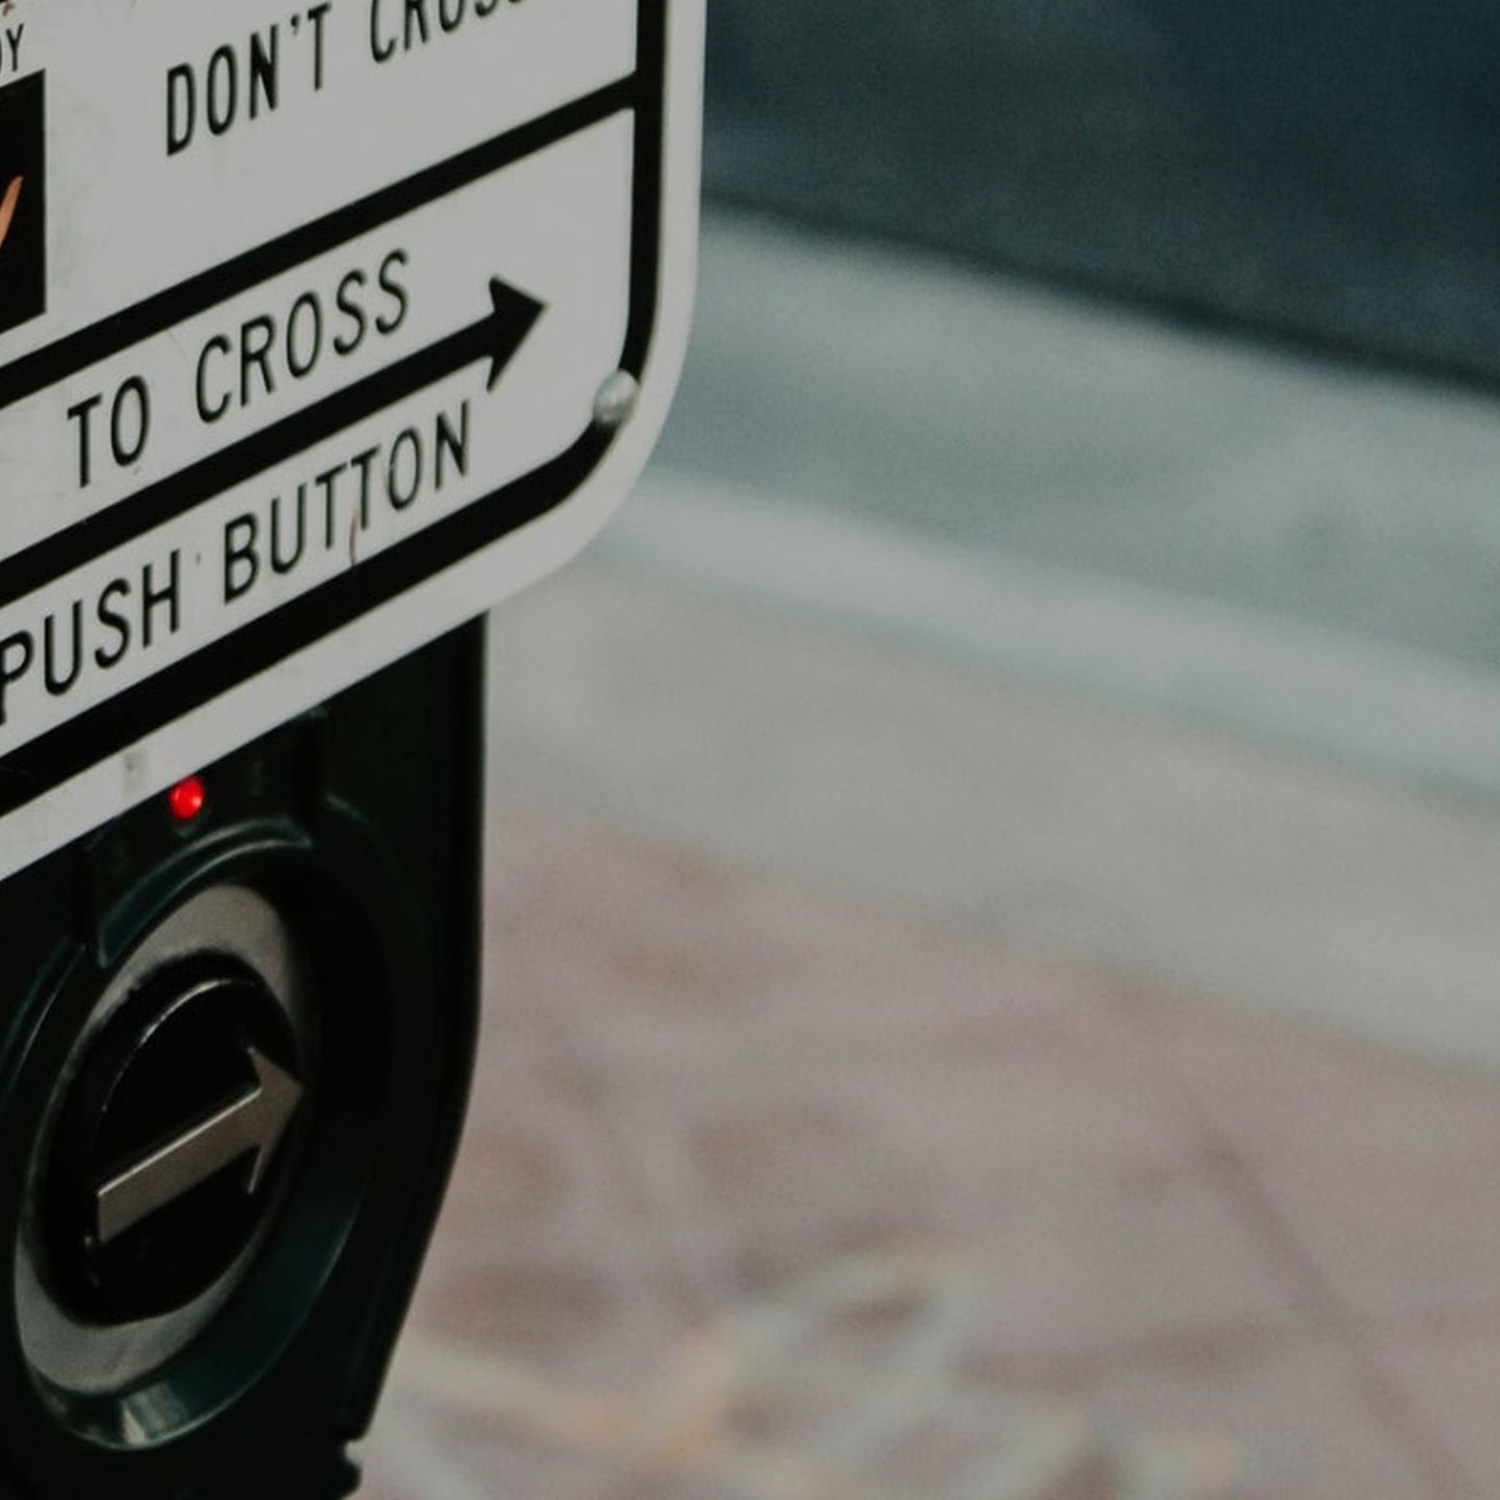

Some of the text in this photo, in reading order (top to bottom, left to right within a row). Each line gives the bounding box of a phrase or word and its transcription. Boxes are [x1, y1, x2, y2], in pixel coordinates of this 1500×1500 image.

[166, 2, 330, 157] DON'T
[67, 249, 407, 488] TO CROSS
[223, 401, 468, 604] BUTTON
